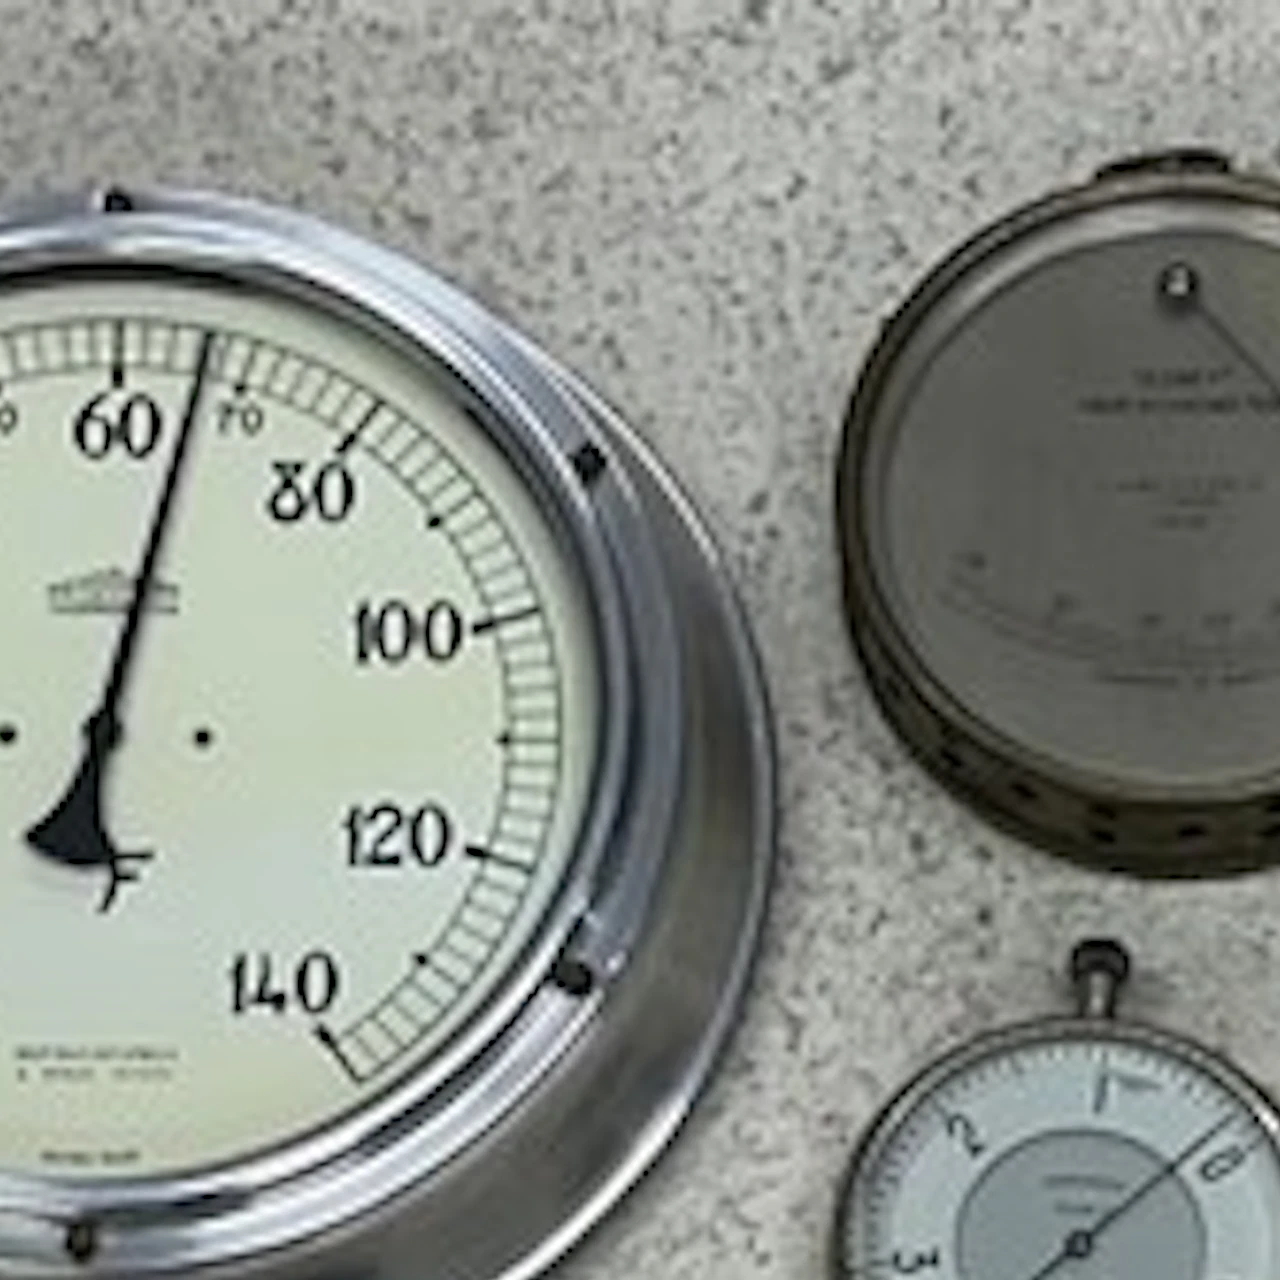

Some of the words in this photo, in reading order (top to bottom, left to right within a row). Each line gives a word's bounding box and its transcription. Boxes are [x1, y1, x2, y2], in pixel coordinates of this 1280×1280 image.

[73, 393, 165, 459] 60
[216, 405, 263, 436] 70
[265, 461, 355, 521] 80
[352, 601, 464, 660] 100
[340, 804, 452, 868] 120
[229, 950, 338, 1014] 140
[947, 1112, 986, 1158] 2
[892, 1245, 940, 1275] 3
